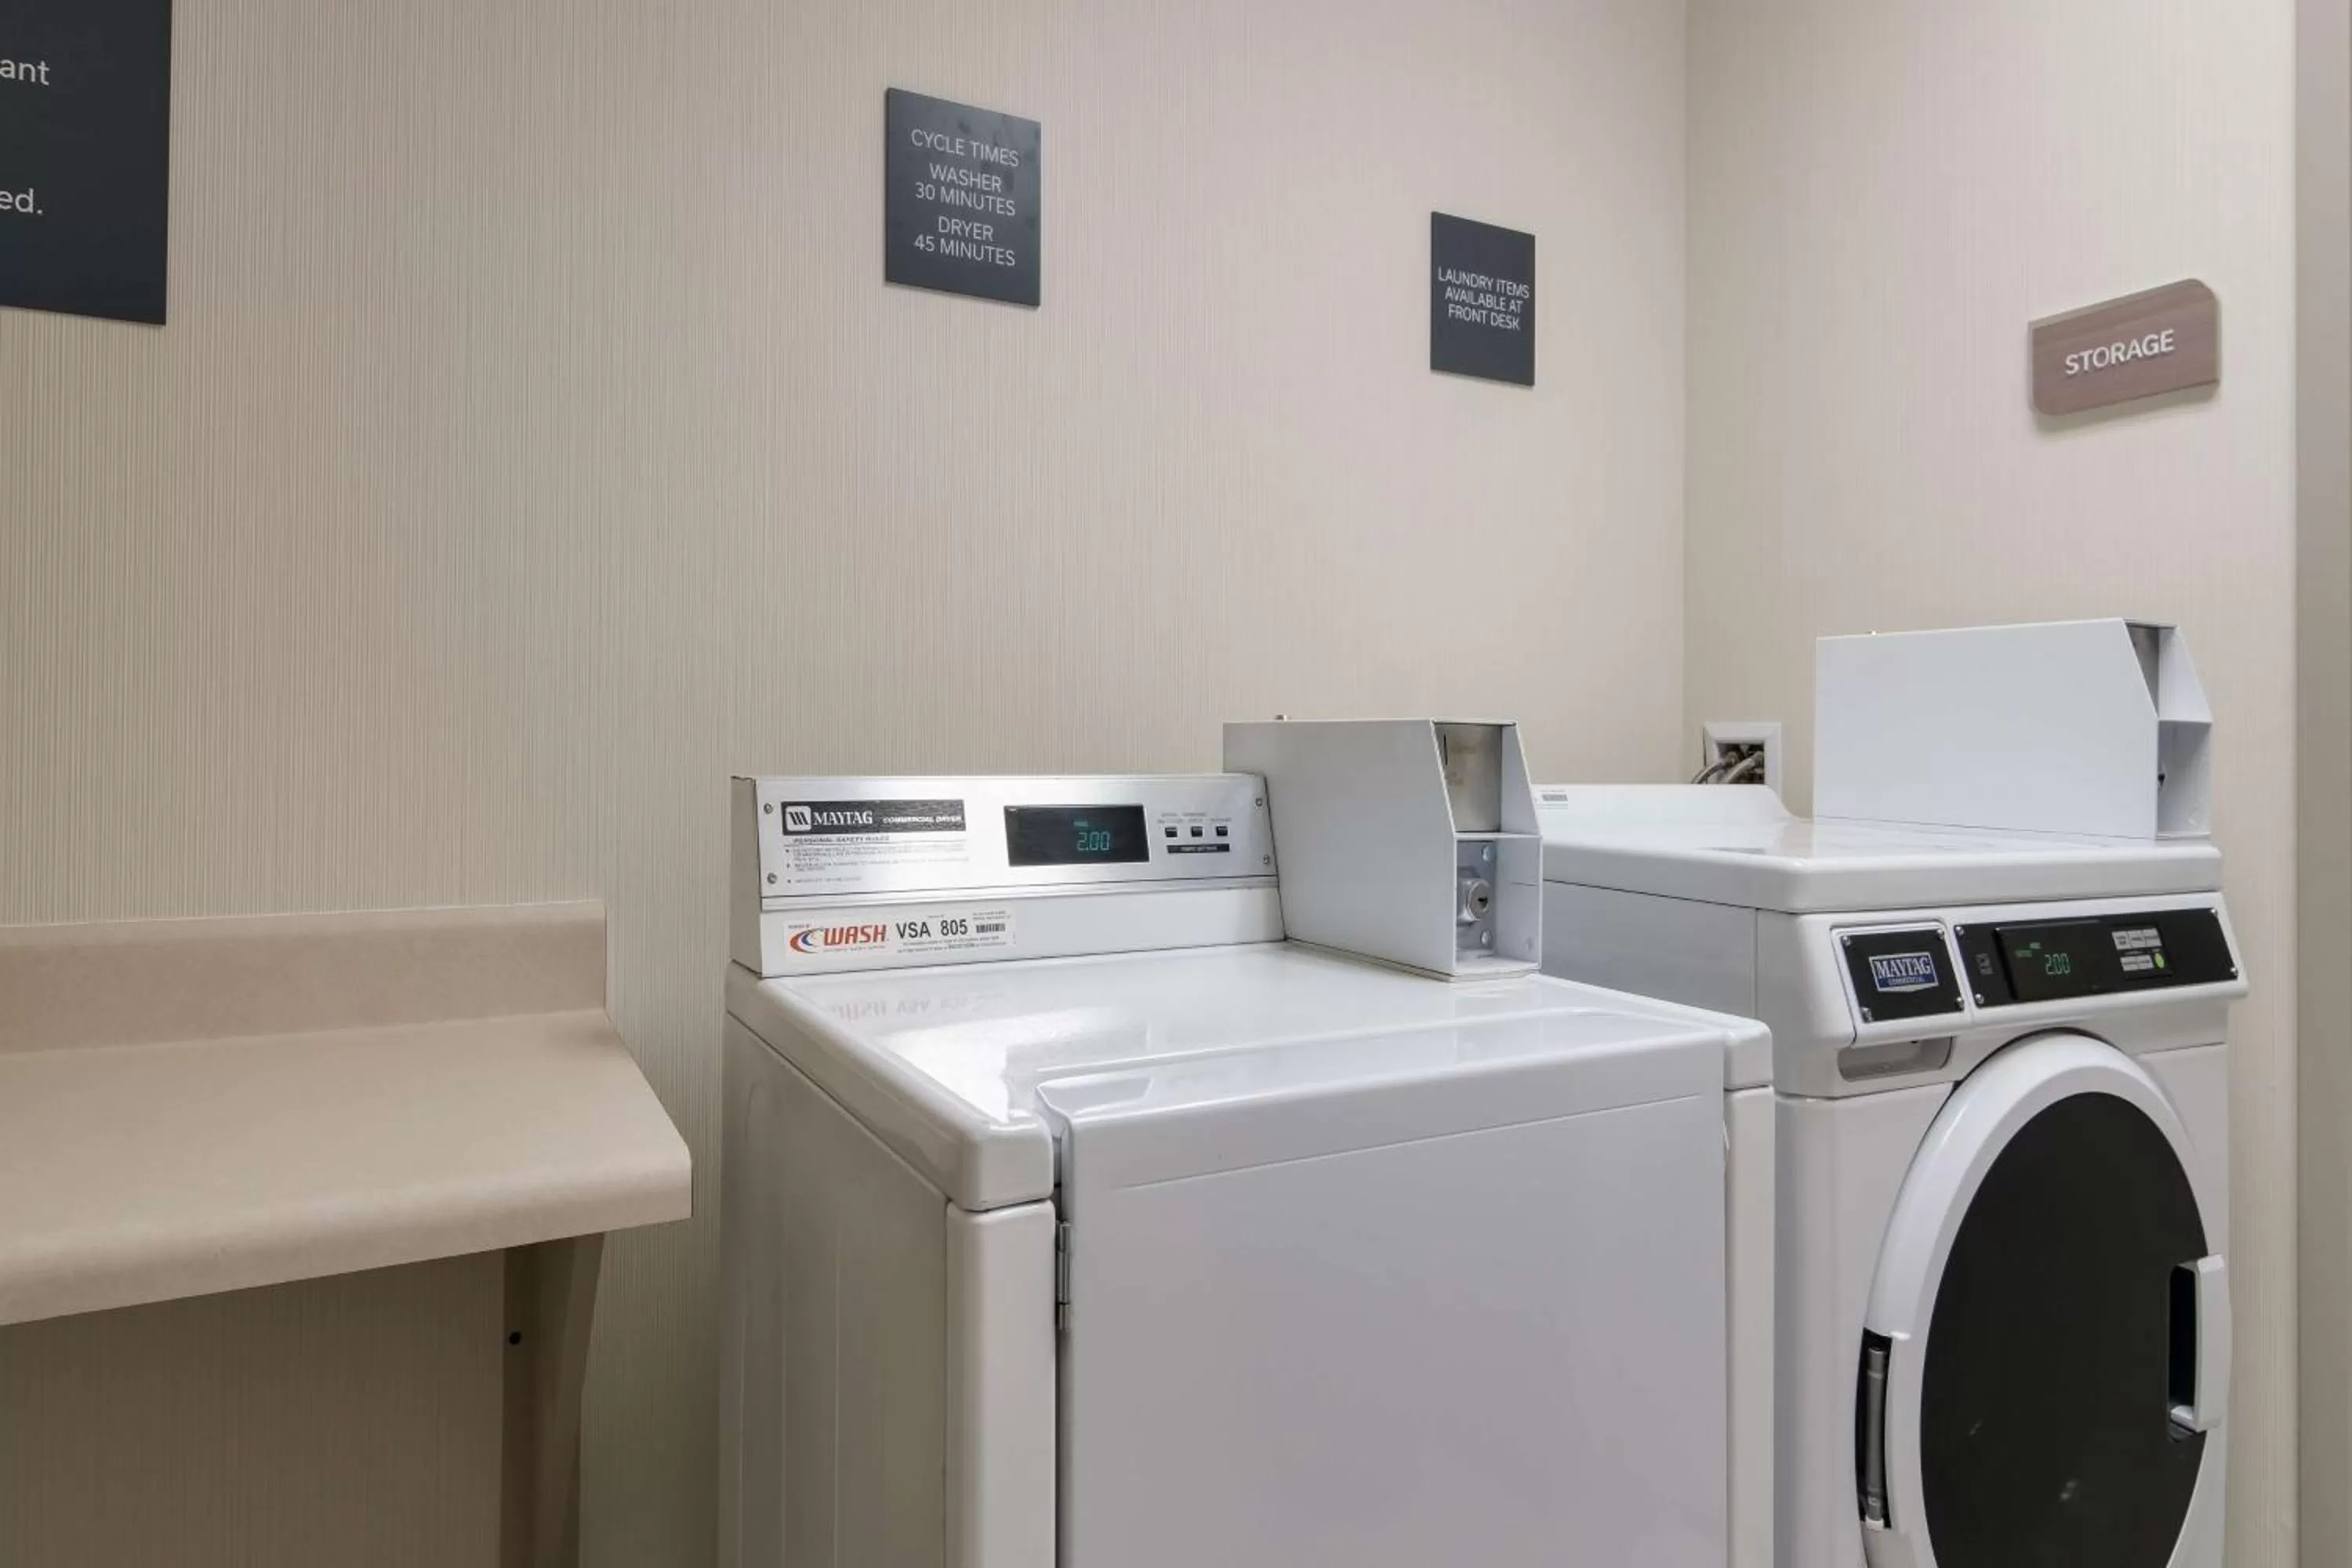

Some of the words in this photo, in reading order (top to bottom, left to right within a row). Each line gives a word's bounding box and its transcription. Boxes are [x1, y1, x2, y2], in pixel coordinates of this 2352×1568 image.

[911, 129, 965, 155] CYCLE
[969, 141, 1020, 167] TIMES
[930, 163, 1002, 193] WASHER
[915, 182, 935, 201] 30
[941, 186, 1016, 216] MINUTES
[938, 216, 994, 242] DRYER
[913, 234, 935, 252] 45
[940, 238, 1016, 267] MINUTES
[1438, 267, 1494, 291] LAUNDRY
[1496, 278, 1530, 299] ITEMS
[1445, 286, 1506, 311] AVAILABLE
[1508, 300, 1523, 314] AT
[1448, 304, 1488, 325] FRONT
[1490, 312, 1521, 331] DESK
[2064, 328, 2175, 375] STORAGE
[813, 810, 873, 826] MAYTAG
[824, 924, 887, 946] WASH
[895, 921, 931, 939] VSA
[940, 918, 968, 936] 805
[1873, 956, 1932, 979] MAYTAG
